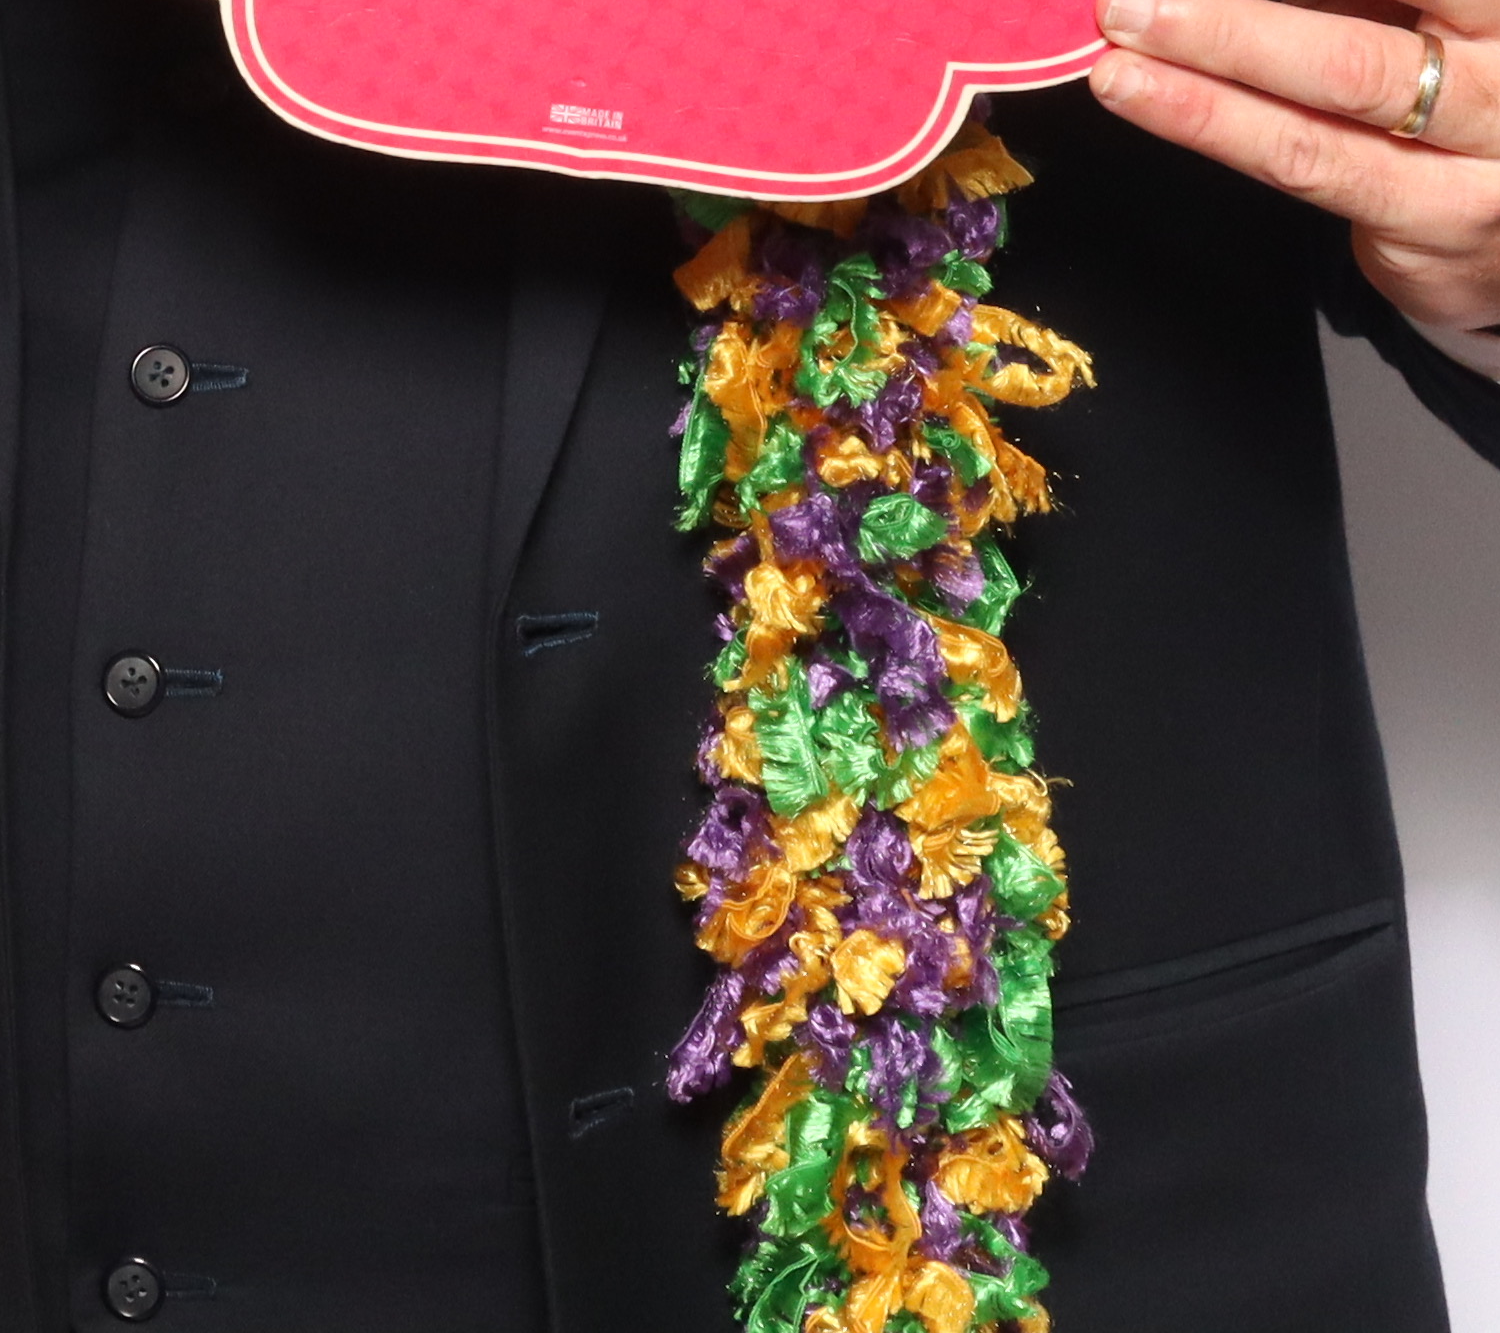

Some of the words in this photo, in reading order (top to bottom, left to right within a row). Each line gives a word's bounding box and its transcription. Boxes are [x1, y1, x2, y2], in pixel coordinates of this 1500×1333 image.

[581, 107, 610, 119] MADE
[612, 111, 624, 121] IN
[580, 116, 623, 130] BRITAIN
